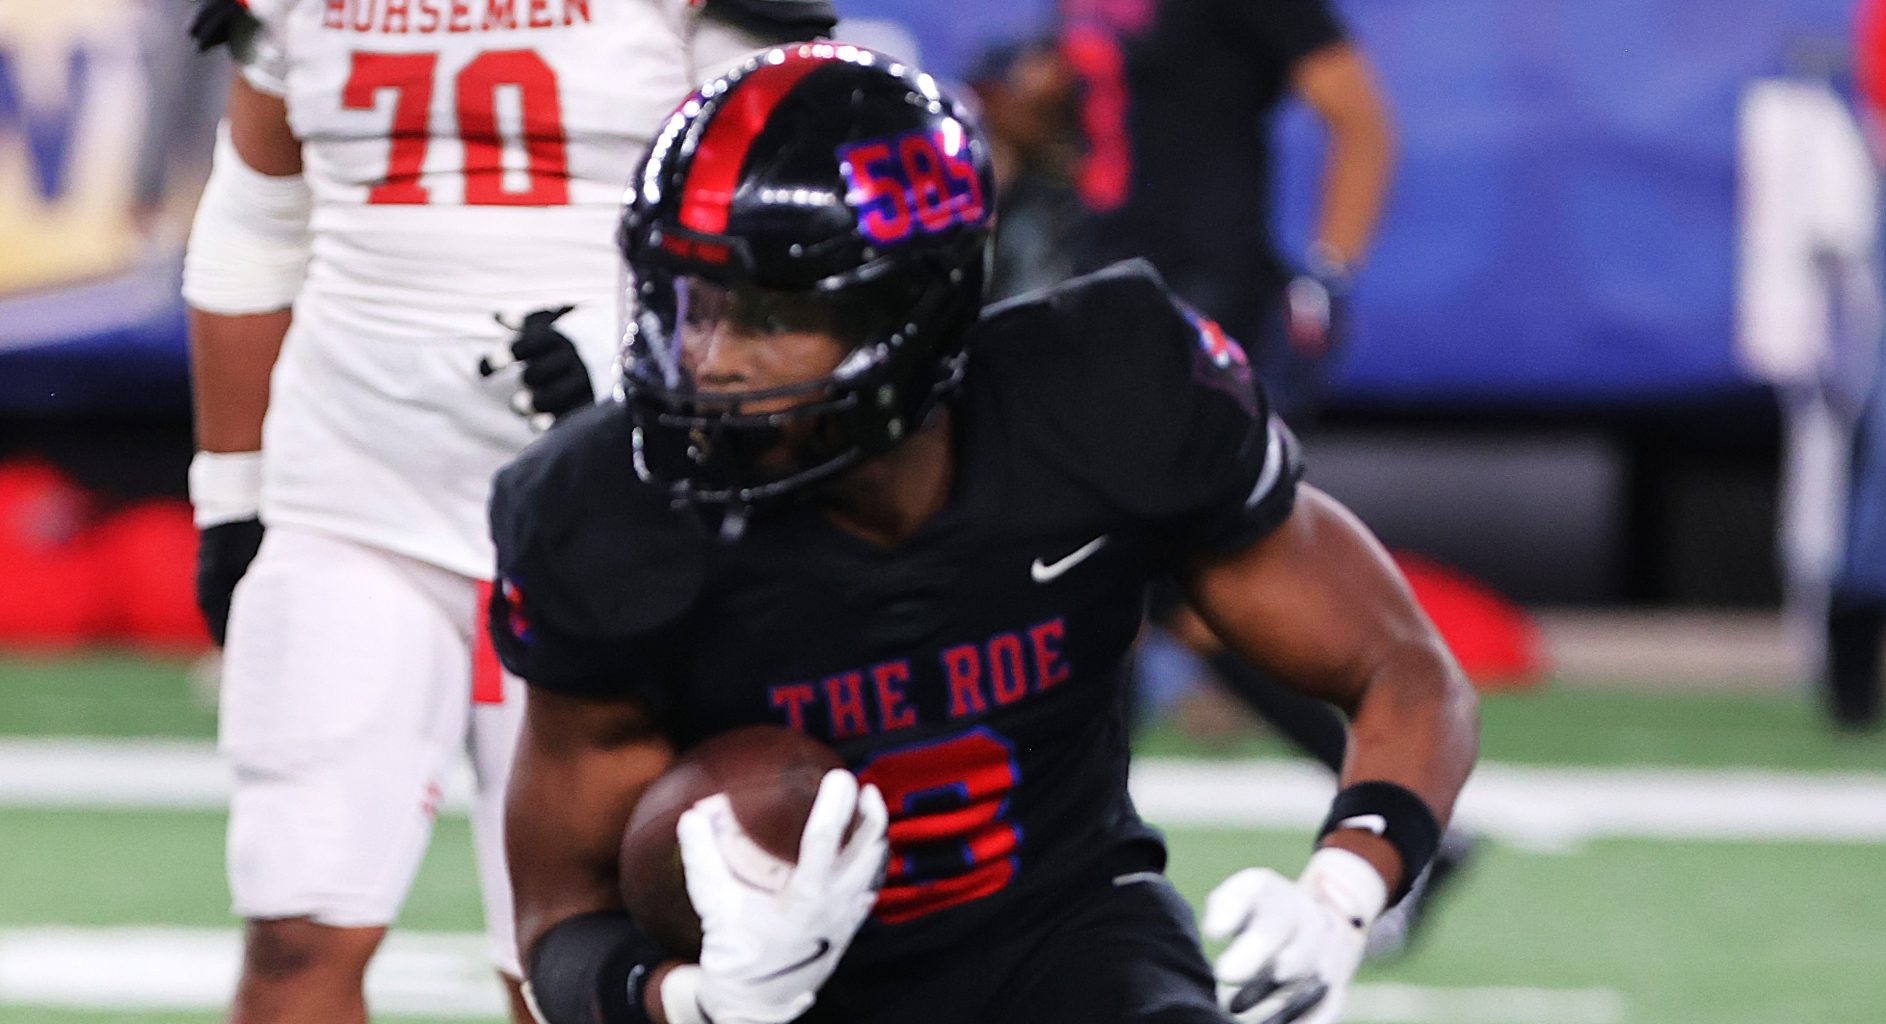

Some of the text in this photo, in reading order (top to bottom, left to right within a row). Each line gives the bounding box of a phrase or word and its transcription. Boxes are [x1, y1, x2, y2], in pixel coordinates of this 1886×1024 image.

[341, 48, 570, 206] 70
[837, 127, 986, 247] 585
[769, 616, 1070, 739] THE ROE
